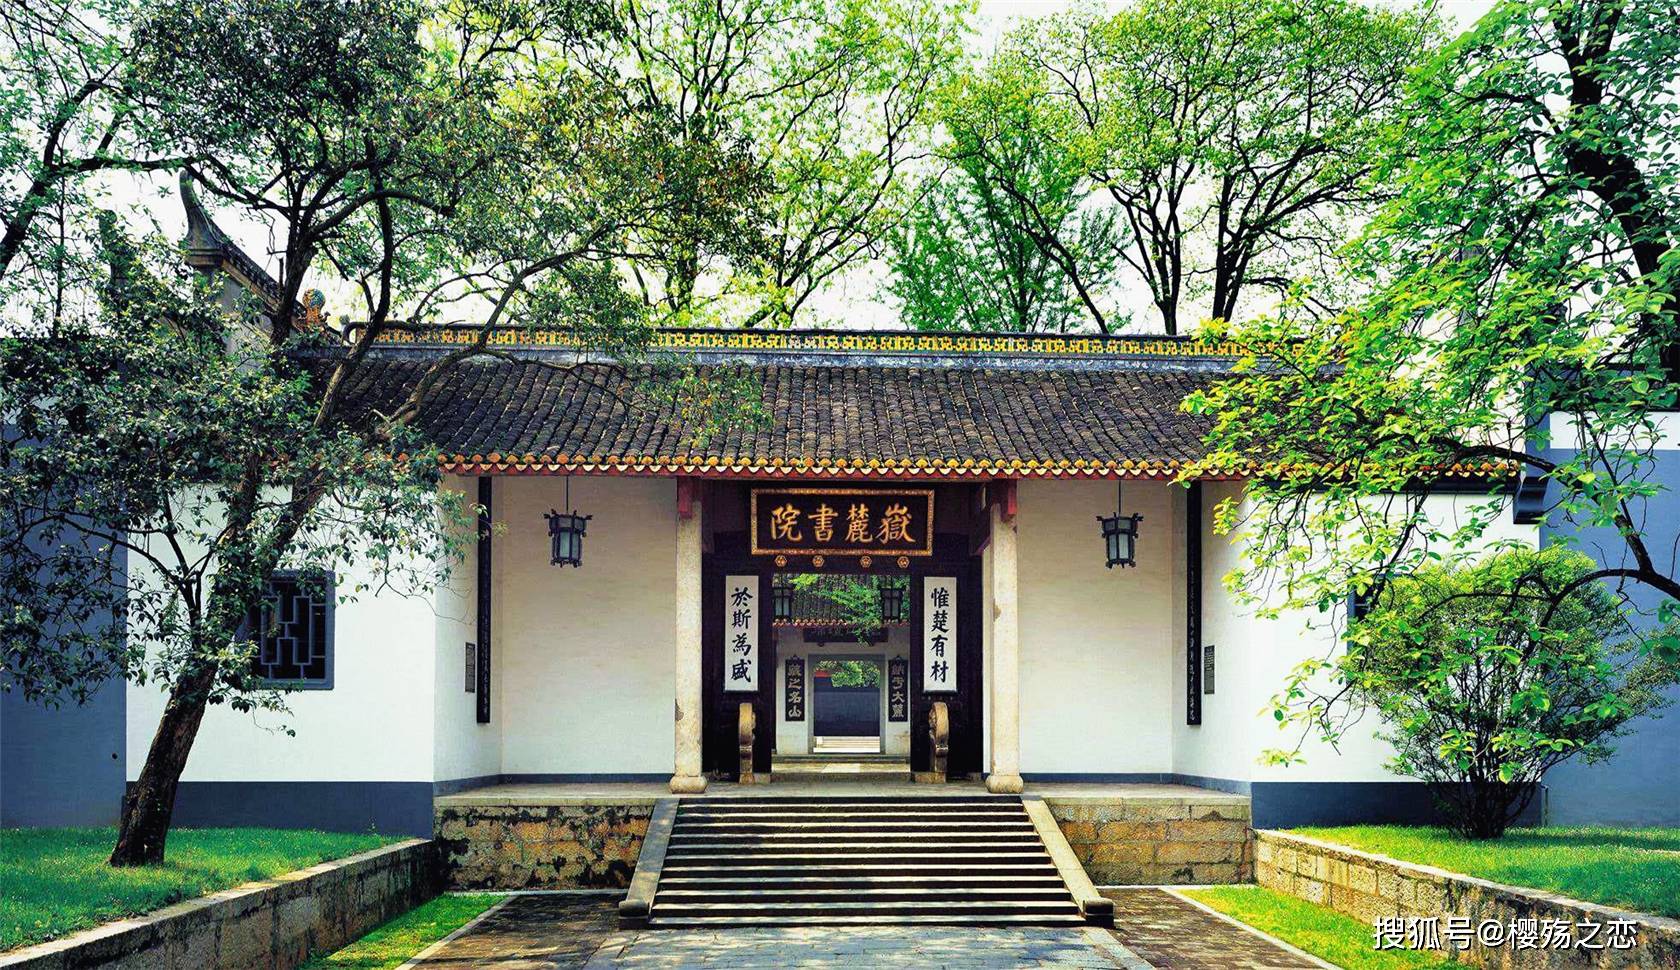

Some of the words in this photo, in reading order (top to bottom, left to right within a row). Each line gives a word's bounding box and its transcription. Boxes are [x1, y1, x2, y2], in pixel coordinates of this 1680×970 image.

[770, 503, 916, 545] 嶽麓書院
[731, 586, 753, 683] 於斯為盛
[930, 587, 950, 683] 惟楚有材
